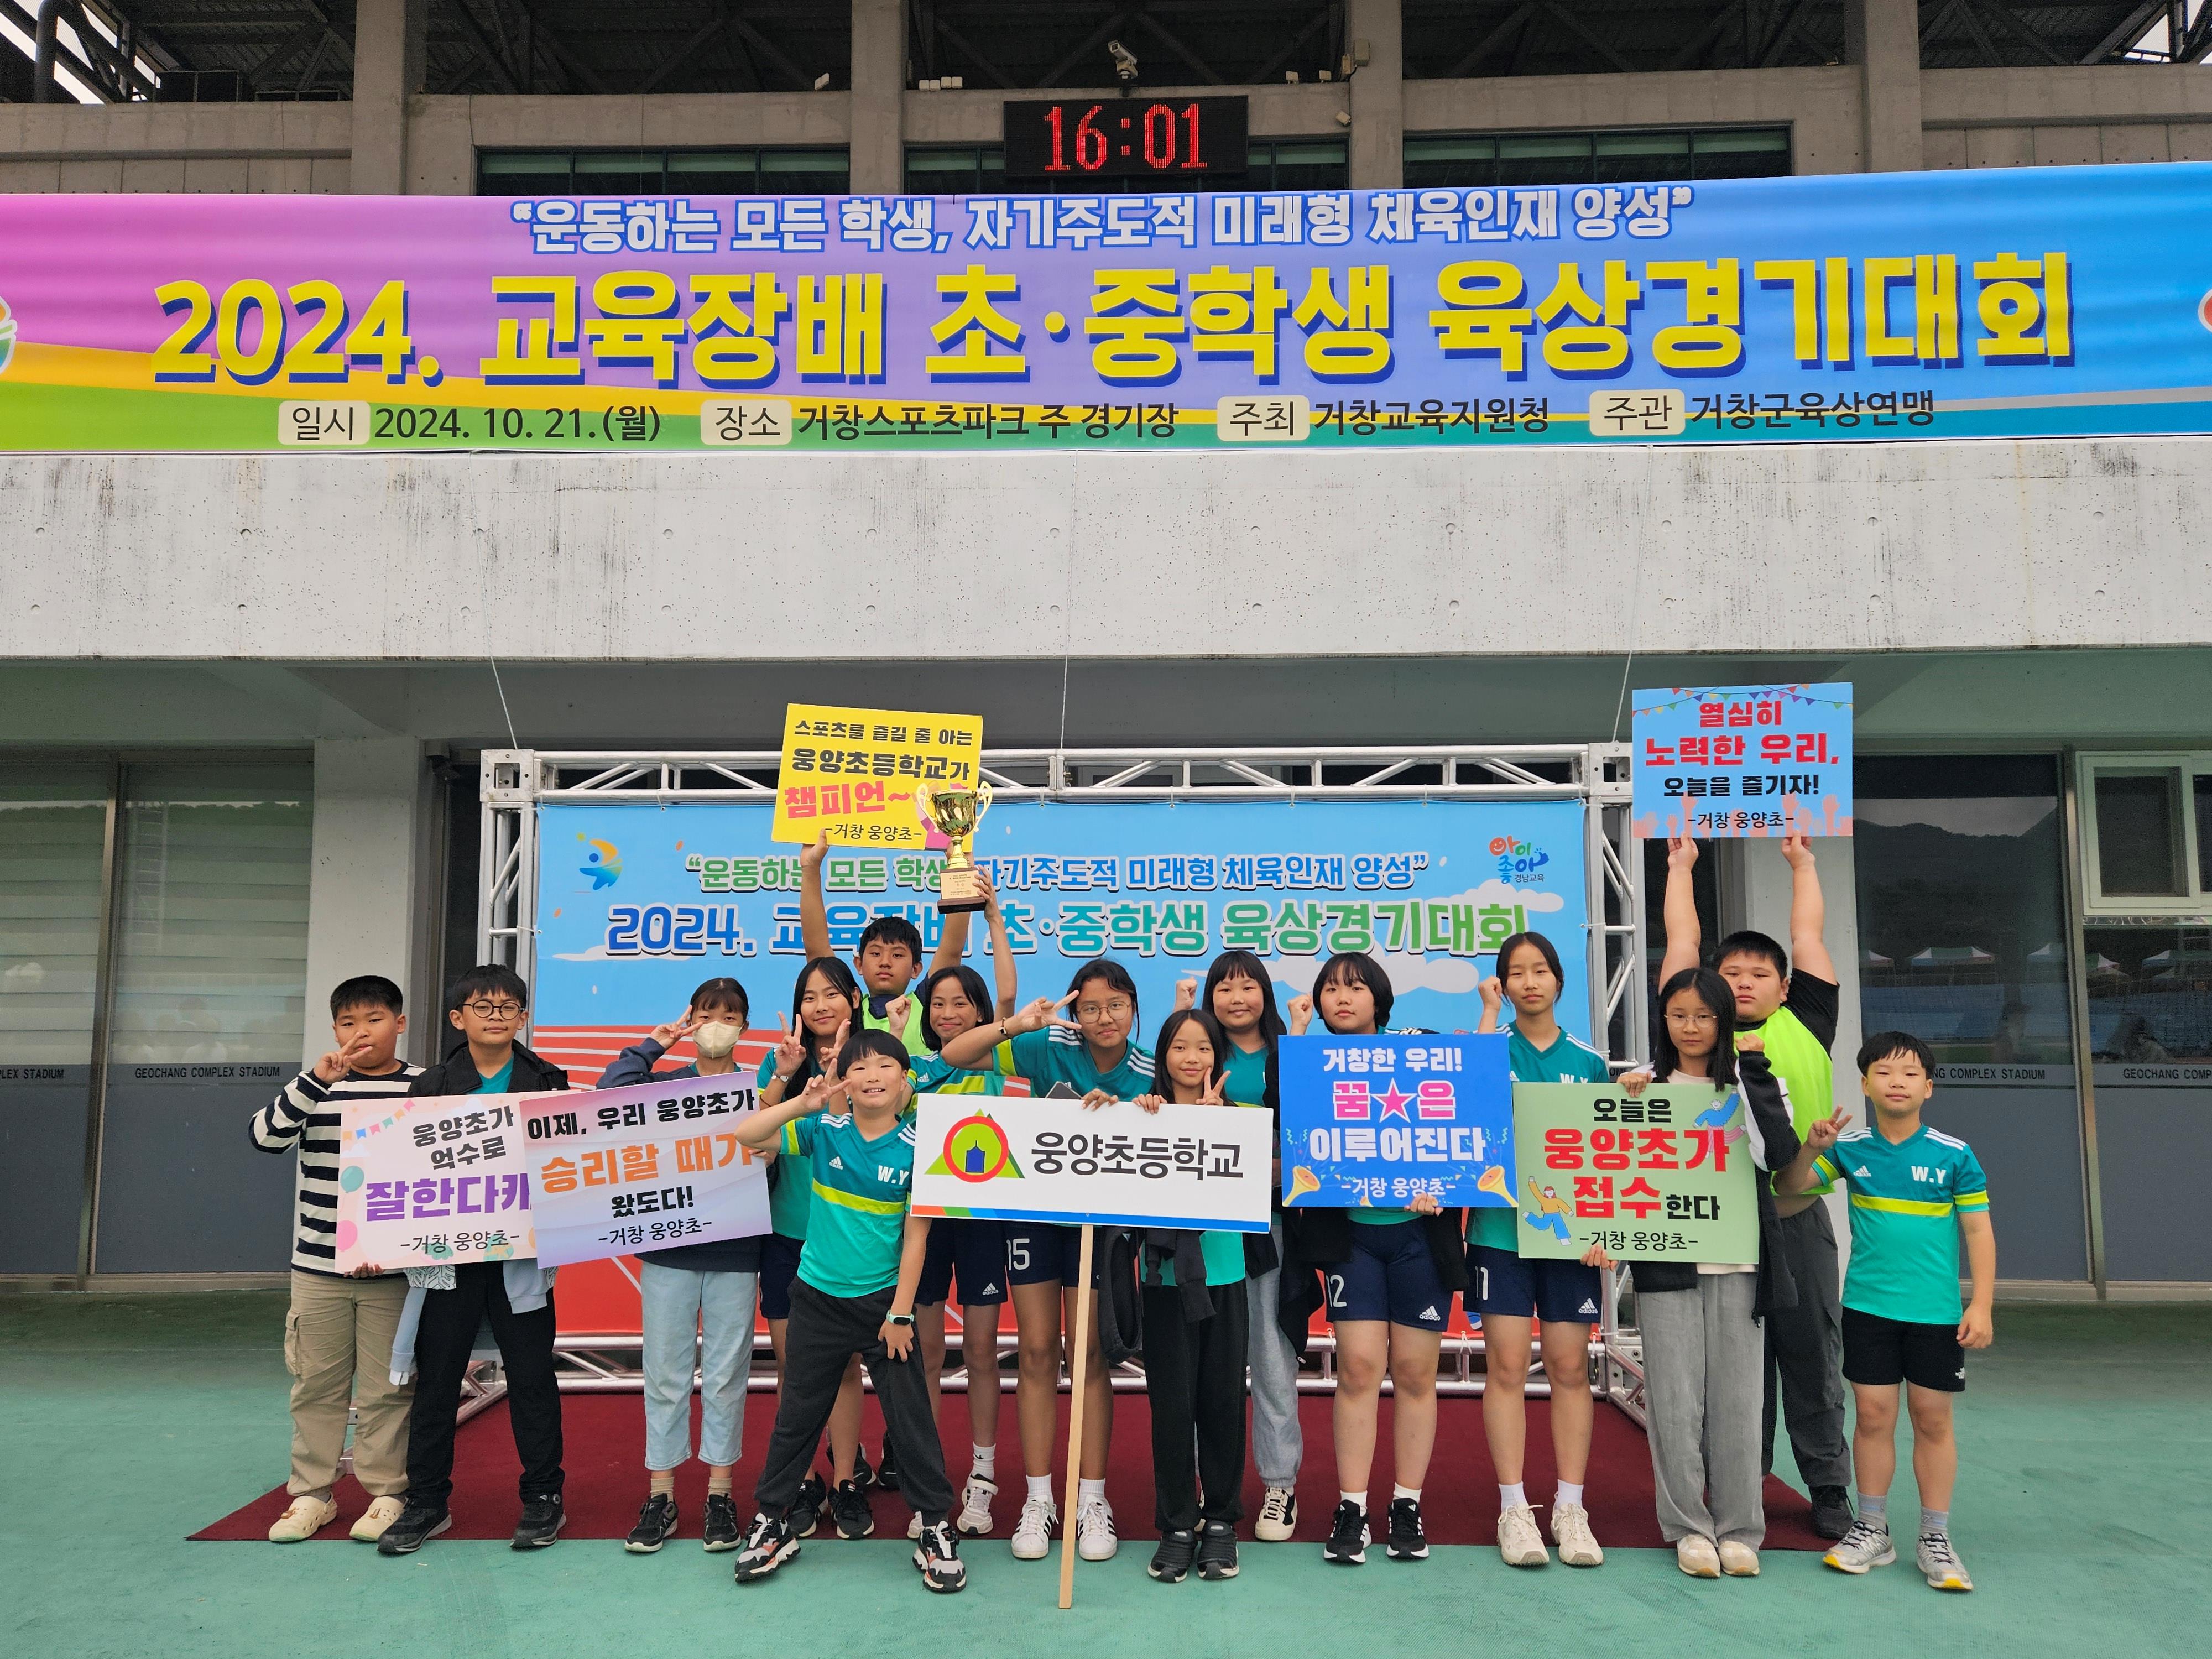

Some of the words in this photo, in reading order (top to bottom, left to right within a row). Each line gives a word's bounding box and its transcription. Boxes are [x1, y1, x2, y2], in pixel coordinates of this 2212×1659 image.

[1044, 103, 1208, 172] 16:01
[731, 199, 828, 253] 모든
[841, 197, 954, 252] 학생,
[967, 195, 1196, 250] 자기주도적
[1214, 191, 1352, 246] 미래형
[1368, 189, 1559, 243] 체육인재
[150, 278, 444, 385] 2024.
[479, 269, 888, 392] 교육장배
[1428, 252, 2075, 382] 육상경기대회
[291, 407, 357, 441] 일시
[374, 407, 469, 439] 2024.
[484, 407, 533, 439] 10.
[715, 405, 781, 440] 장소
[798, 404, 1030, 442] 거창스포츠파크
[1038, 403, 1071, 437] 주
[1080, 403, 1179, 439] 경기장
[1229, 401, 1295, 437] 주최
[1313, 397, 1550, 437] 거창교육지원청
[1604, 395, 1672, 432] 주관
[1690, 389, 1934, 429] 거창군육상연맹
[1699, 700, 1782, 728] 열심히
[794, 719, 865, 740] 스포츠를
[873, 725, 907, 743] 즐길
[914, 727, 931, 744] 줄
[938, 729, 973, 746] 아는
[1646, 735, 1746, 766] 노력한
[1760, 733, 1840, 765] 우리,
[791, 748, 970, 781] 웅양초등학교가
[1664, 776, 1731, 797] 오늘을
[1741, 775, 1819, 796] 즐기자!
[828, 859, 884, 887] 모든
[1129, 857, 1214, 886] 미래형
[1224, 855, 1343, 886] 체육인재
[1515, 873, 1545, 883] 경남교육
[608, 907, 753, 952] 2024.
[1224, 902, 1526, 952] 육상경기대회
[23, 1068, 65, 1079] STADIUM
[135, 1067, 187, 1078] GEOCHANG
[191, 1067, 234, 1078] COMPLEX
[239, 1066, 280, 1077] STADIUM
[1323, 1047, 1396, 1073] 거창한
[1405, 1047, 1463, 1072] 우리!
[1950, 1067, 1996, 1079] COMPLEX
[2001, 1068, 2046, 1079] STADIUM
[2123, 1068, 2179, 1079] GEOCHANG
[413, 1105, 514, 1147] 웅양초가
[527, 1113, 587, 1139] 이제,
[598, 1103, 646, 1130] 우리
[656, 1088, 755, 1123] 웅양초가
[1593, 1098, 1672, 1123] 오늘은
[430, 1135, 507, 1170] 억수로
[1031, 1131, 1244, 1181] 웅양초등학교
[1309, 1126, 1486, 1162] 이루어진다
[1544, 1128, 1730, 1172] 웅양초가
[541, 1143, 660, 1194] 승리할
[877, 1165, 910, 1186] W.Y
[1911, 1165, 1947, 1185] W.Y
[366, 1172, 532, 1222] 잘한다카
[611, 1185, 694, 1219] 왔도다!
[1573, 1176, 1662, 1219] 접수
[1665, 1194, 1721, 1221] 한다
[1006, 1238, 1030, 1271] 15
[1326, 1274, 1347, 1308] 12
